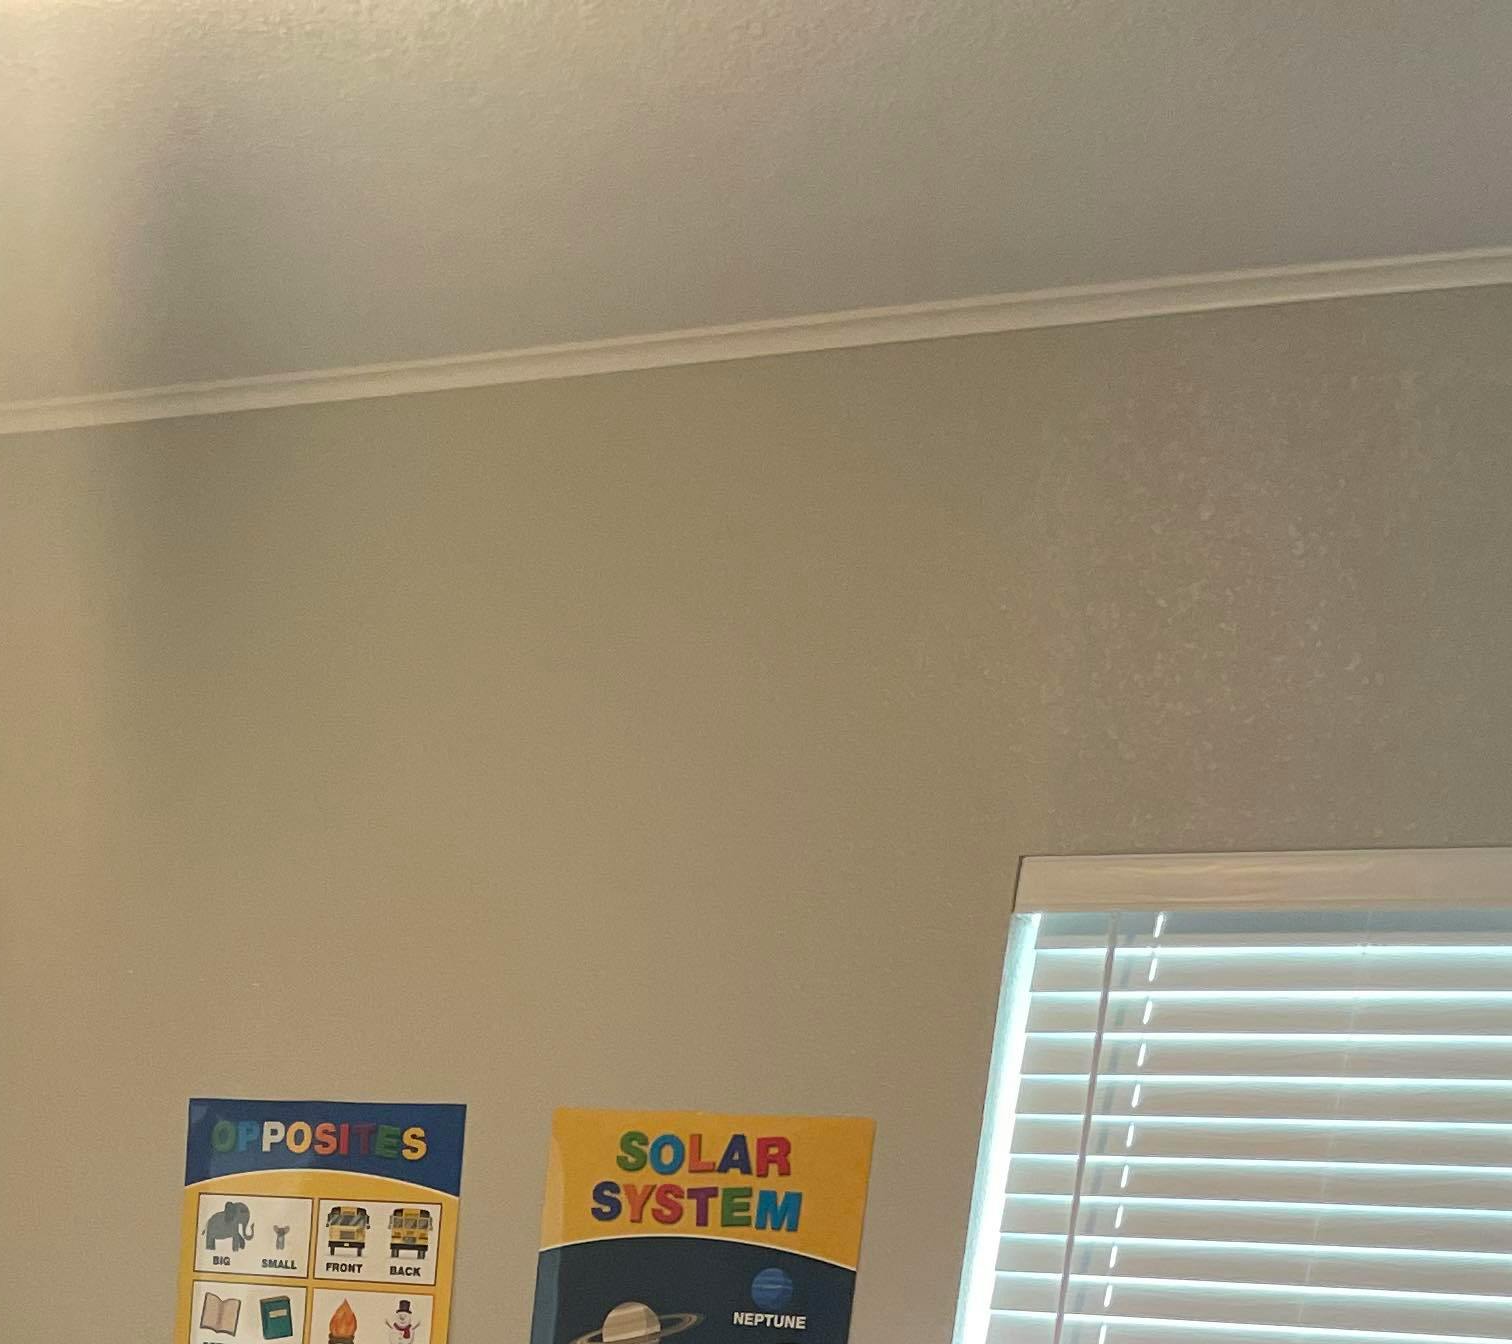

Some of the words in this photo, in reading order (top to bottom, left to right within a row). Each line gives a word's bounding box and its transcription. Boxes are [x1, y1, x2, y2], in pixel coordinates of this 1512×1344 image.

[210, 1120, 428, 1160] OPPOSITES
[616, 1130, 792, 1177] SOLAR
[590, 1181, 802, 1232] SYSTEM
[212, 1255, 231, 1266] BIG
[261, 1258, 297, 1270] SMALL
[325, 1262, 363, 1274] FRONT
[389, 1265, 421, 1277] BACK
[733, 1312, 806, 1330] NEPTUNE
